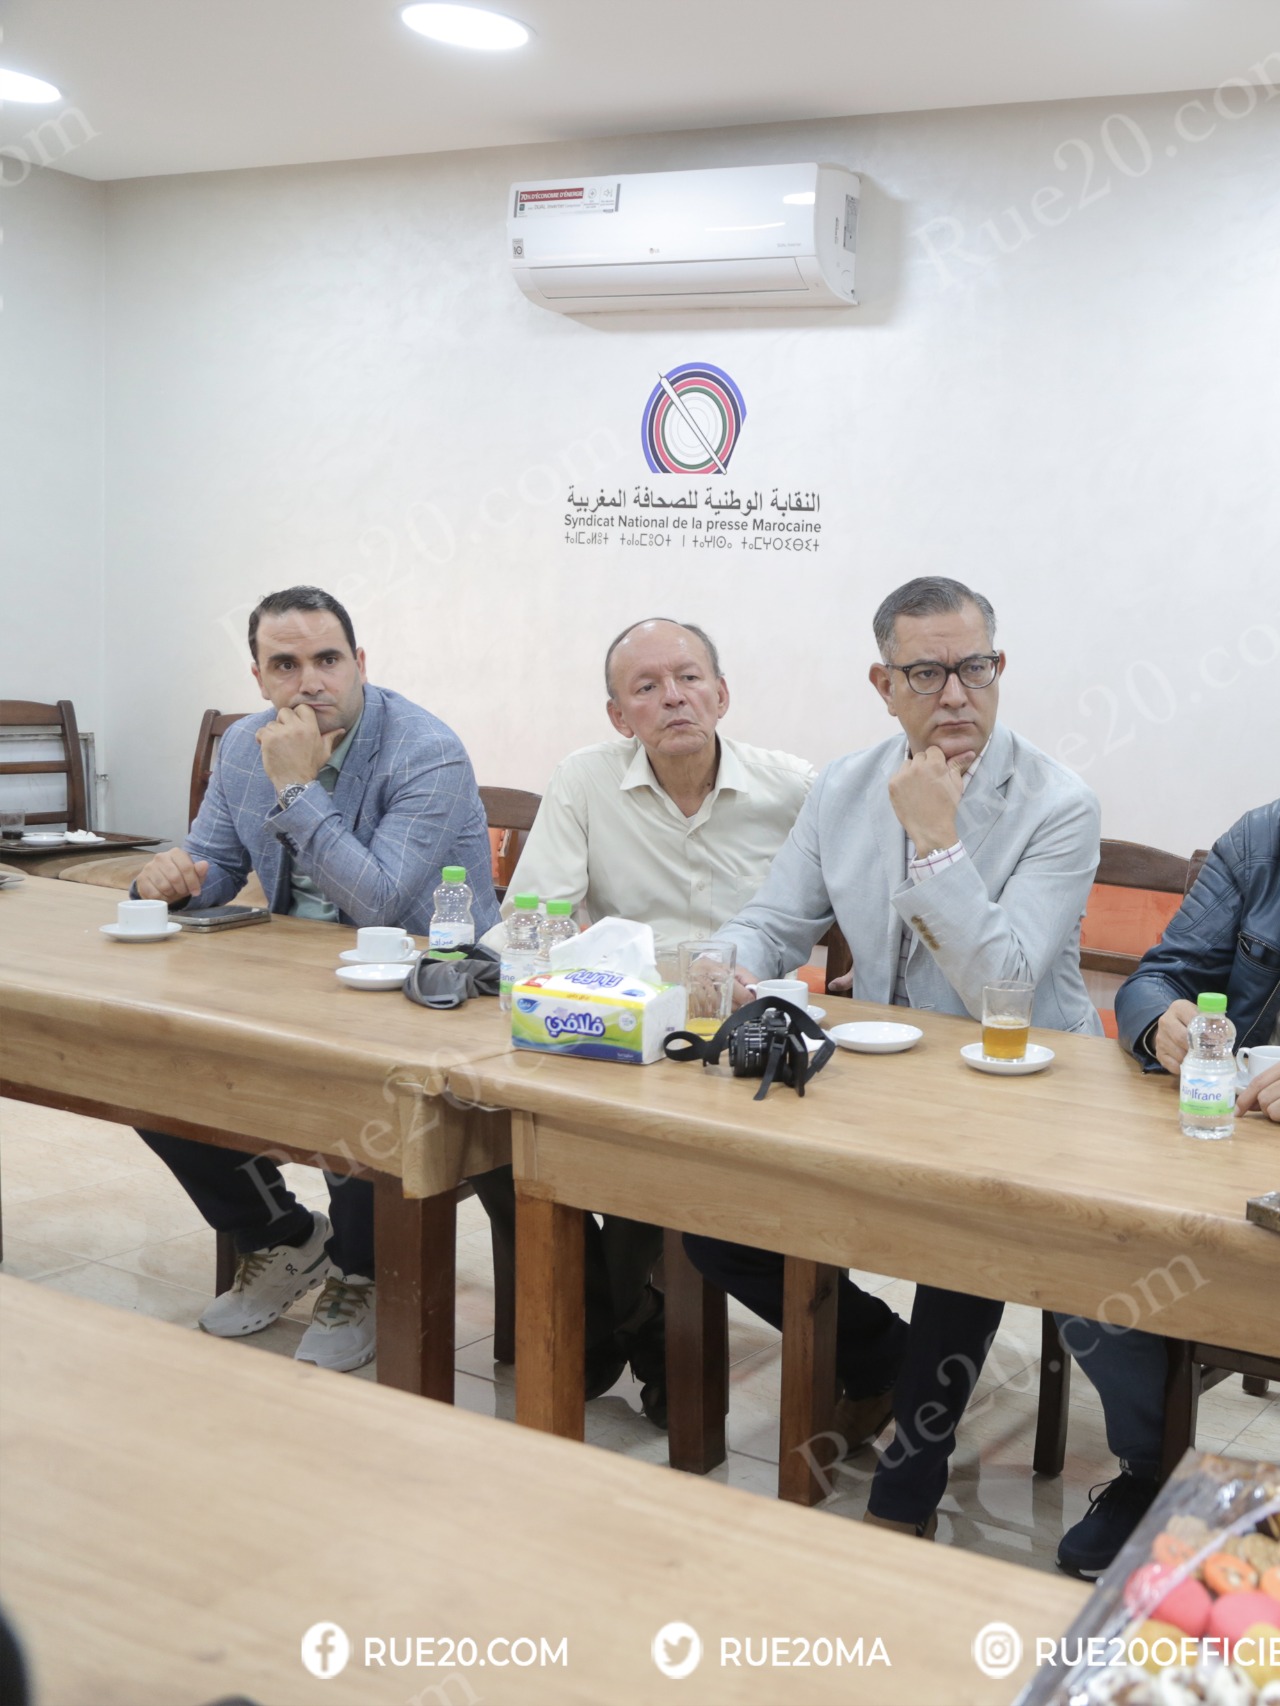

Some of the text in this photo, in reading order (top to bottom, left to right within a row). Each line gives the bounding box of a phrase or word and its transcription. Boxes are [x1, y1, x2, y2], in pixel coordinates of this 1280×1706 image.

[567, 484, 821, 518] النقابة الوطنية للصحافة المغربية
[564, 513, 822, 533] Syndicat National de la presse Marocaine
